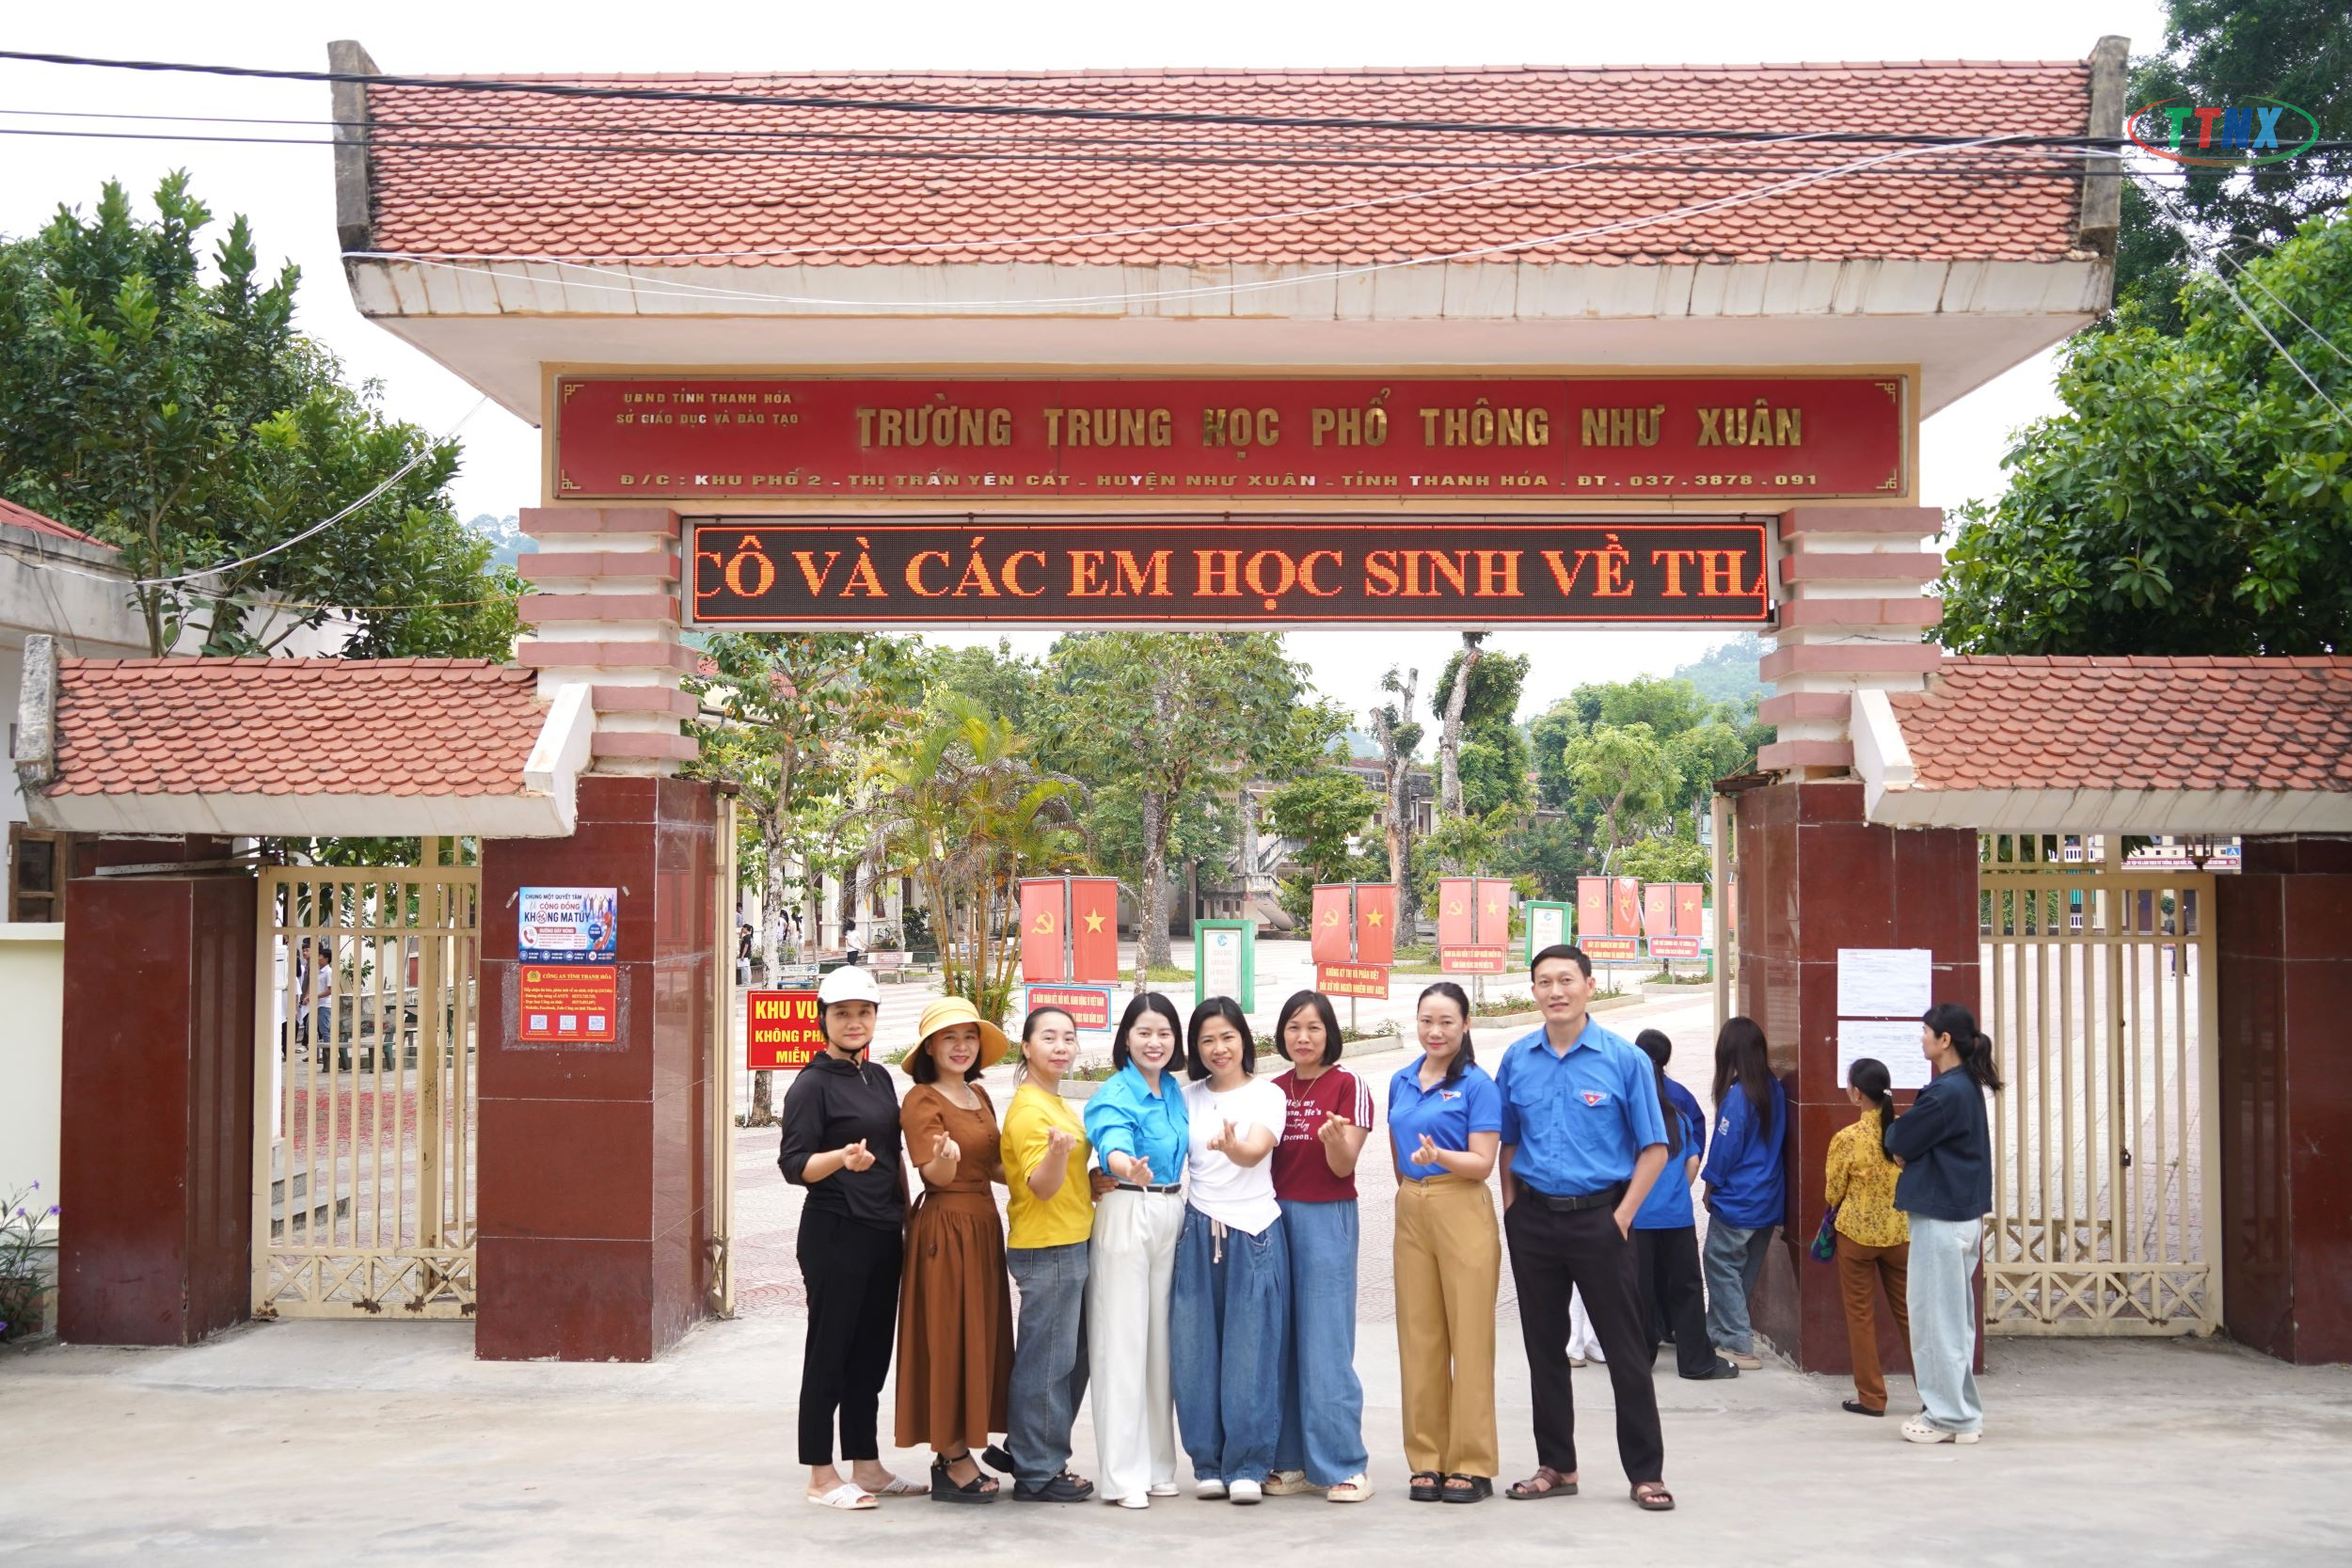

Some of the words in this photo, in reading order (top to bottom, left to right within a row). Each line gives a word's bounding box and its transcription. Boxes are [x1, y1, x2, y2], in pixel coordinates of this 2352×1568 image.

[625, 393, 666, 404] UBND
[710, 393, 756, 404] THANH
[764, 390, 792, 404] HÓA
[642, 409, 673, 423] GIÁO
[680, 414, 707, 427] DỤC
[772, 414, 798, 427] TẠO
[855, 393, 1011, 448] TRƯỜNG
[1043, 407, 1172, 448] TRUNG
[1202, 407, 1280, 460] HỌC
[1311, 387, 1391, 447] PHỔ
[1420, 397, 1549, 447] THÔNG
[1581, 404, 1665, 447] NHƯ
[1696, 398, 1802, 447] XUÂN
[695, 475, 742, 485] KHU
[753, 467, 802, 485] PHỐ
[808, 475, 821, 485] 2
[849, 475, 885, 490] THỊ
[896, 469, 960, 485] TRẤN
[968, 472, 1014, 485] YÊN
[1025, 469, 1070, 485] CÁT
[1097, 472, 1176, 490] HUYỆN
[1185, 475, 1237, 486] NHƯ
[1248, 472, 1315, 486] XUÂN
[1342, 471, 1398, 485] TỈNH
[1409, 475, 1490, 486] THANH
[1501, 471, 1549, 486] HÓA
[791, 536, 889, 597] VÀ
[905, 536, 1046, 597] CÁC
[1067, 550, 1173, 596] EM
[1192, 550, 1343, 610] HỌC
[1364, 550, 1525, 596] SINH
[1539, 533, 1634, 597] VỀ
[561, 912, 573, 922] MA
[574, 910, 590, 922] TÚY
[755, 1001, 790, 1020] KHU
[755, 1027, 800, 1042] KHÔNG
[775, 1046, 810, 1063] MIỄN
